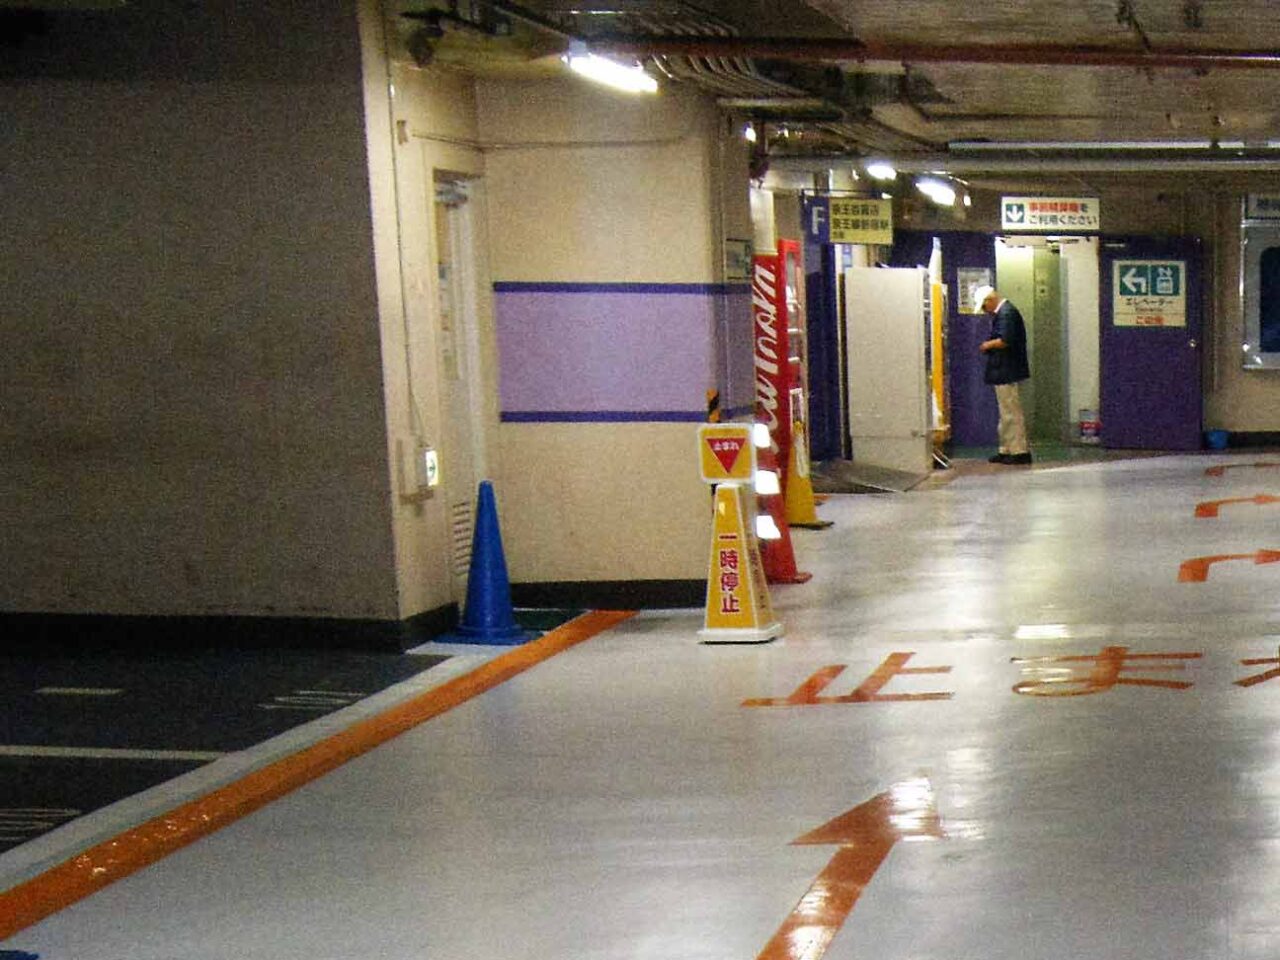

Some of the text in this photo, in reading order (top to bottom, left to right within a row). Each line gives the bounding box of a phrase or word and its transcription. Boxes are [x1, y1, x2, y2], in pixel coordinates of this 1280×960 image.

[713, 441, 740, 450] 止まれ
[719, 534, 740, 613] 一時停止
